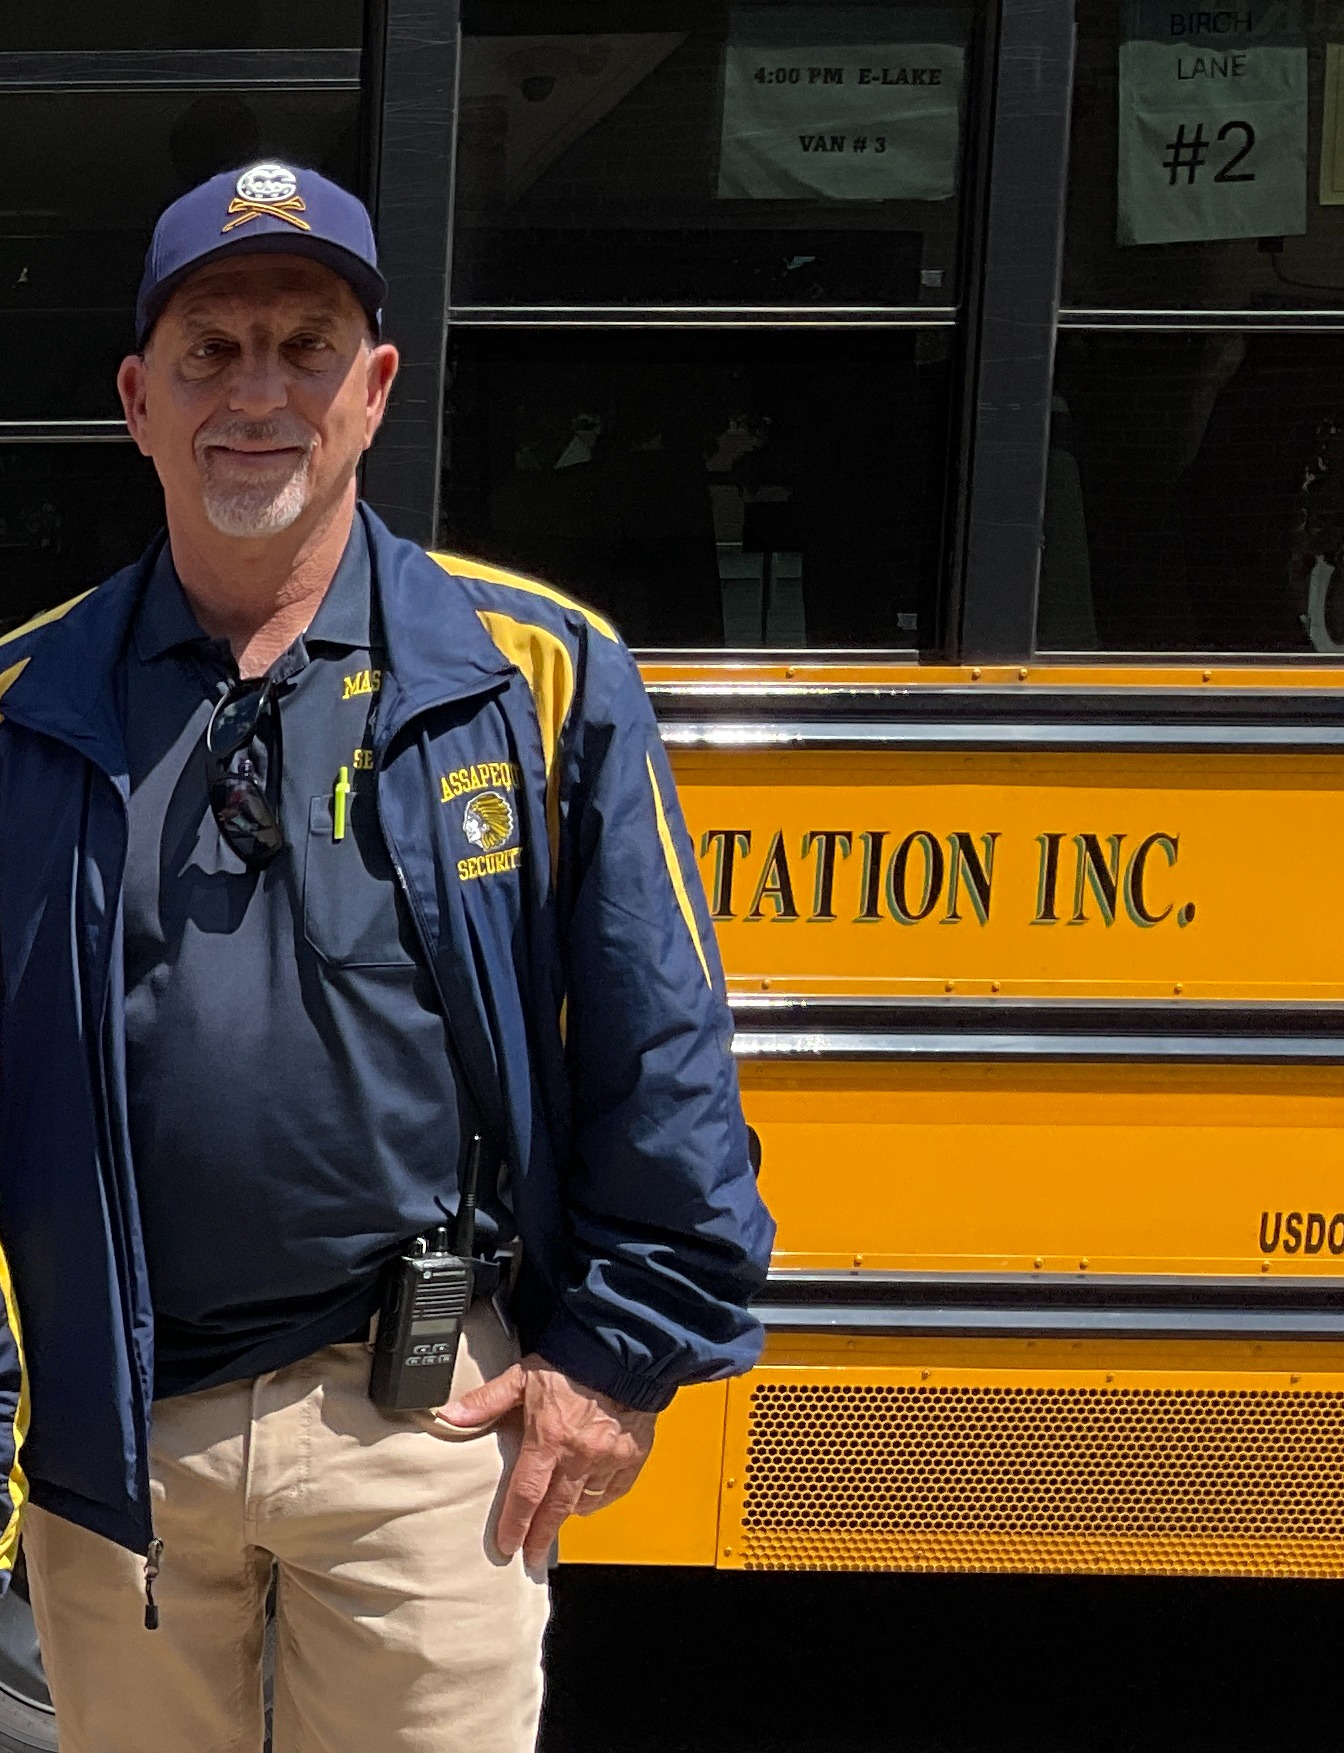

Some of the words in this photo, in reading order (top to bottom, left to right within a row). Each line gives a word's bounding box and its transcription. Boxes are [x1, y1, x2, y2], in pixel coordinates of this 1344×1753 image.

[1170, 11, 1253, 36] BIRCH
[754, 67, 800, 84] 4:00
[808, 67, 844, 84] PM
[858, 68, 942, 85] E-LAKE
[1178, 54, 1247, 80] LANE
[799, 135, 846, 152] VAN
[874, 137, 886, 153] 3
[1163, 120, 1255, 186] #2
[343, 669, 382, 700] MAS
[1029, 832, 1197, 928] INC.
[1259, 1211, 1344, 1255] USDO
